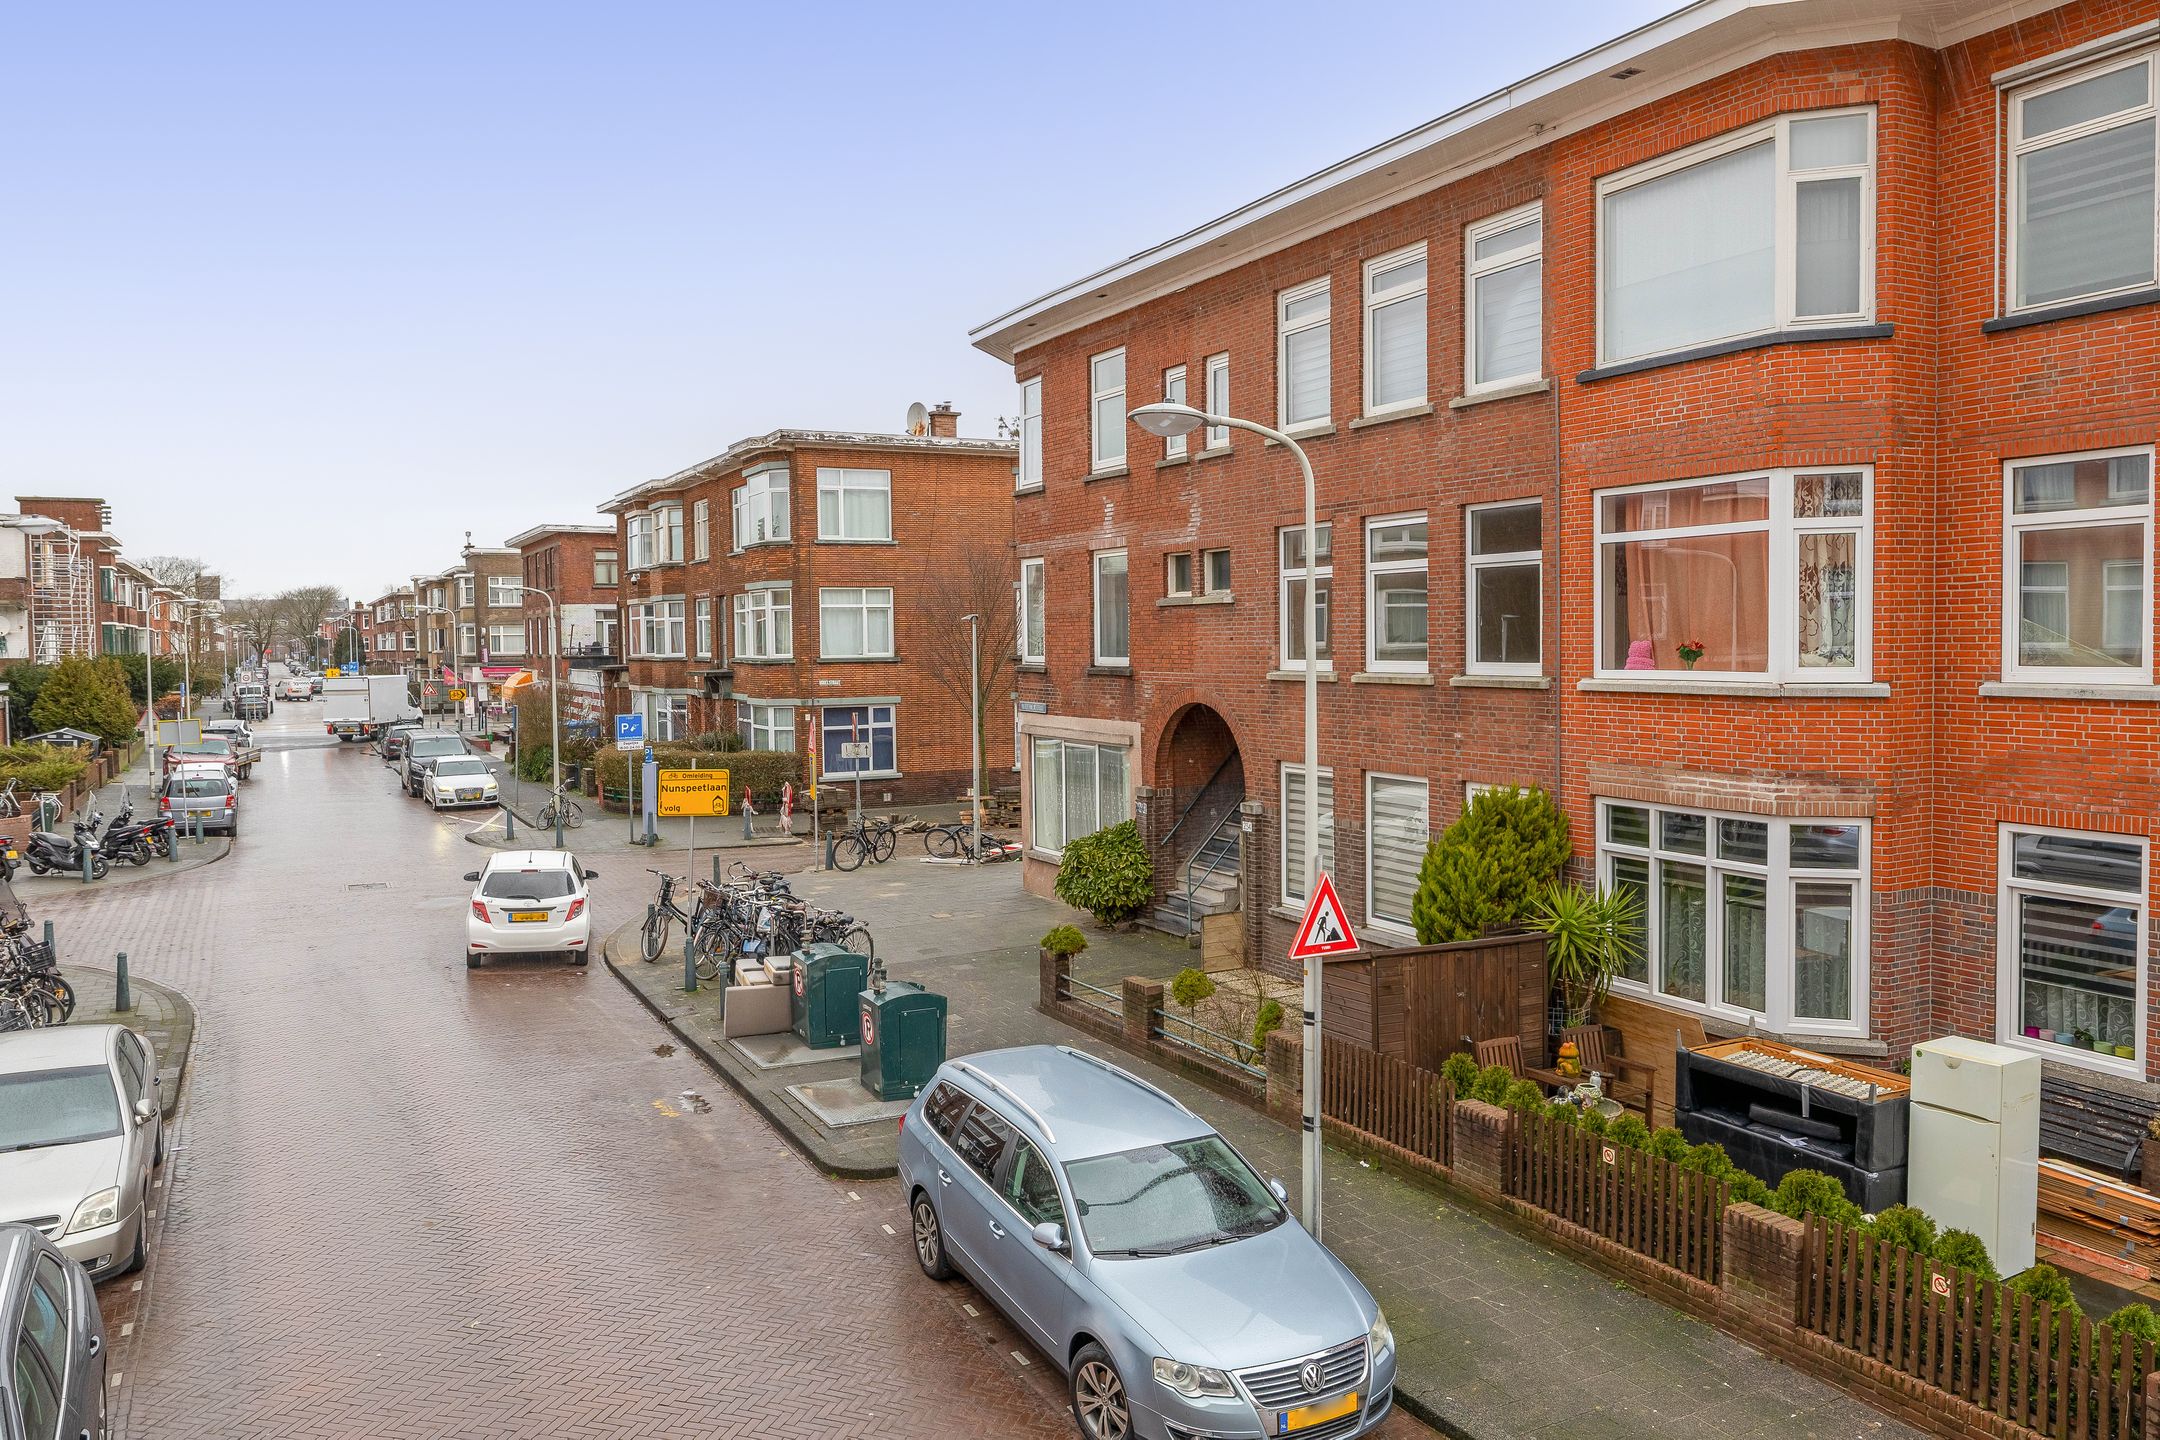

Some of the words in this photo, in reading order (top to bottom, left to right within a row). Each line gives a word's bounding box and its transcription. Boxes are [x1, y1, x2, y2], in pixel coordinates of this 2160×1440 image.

[621, 722, 629, 734] P
[682, 772, 713, 780] Omleiding
[661, 783, 727, 793] Nunspeetlaan
[664, 804, 681, 812] volg
